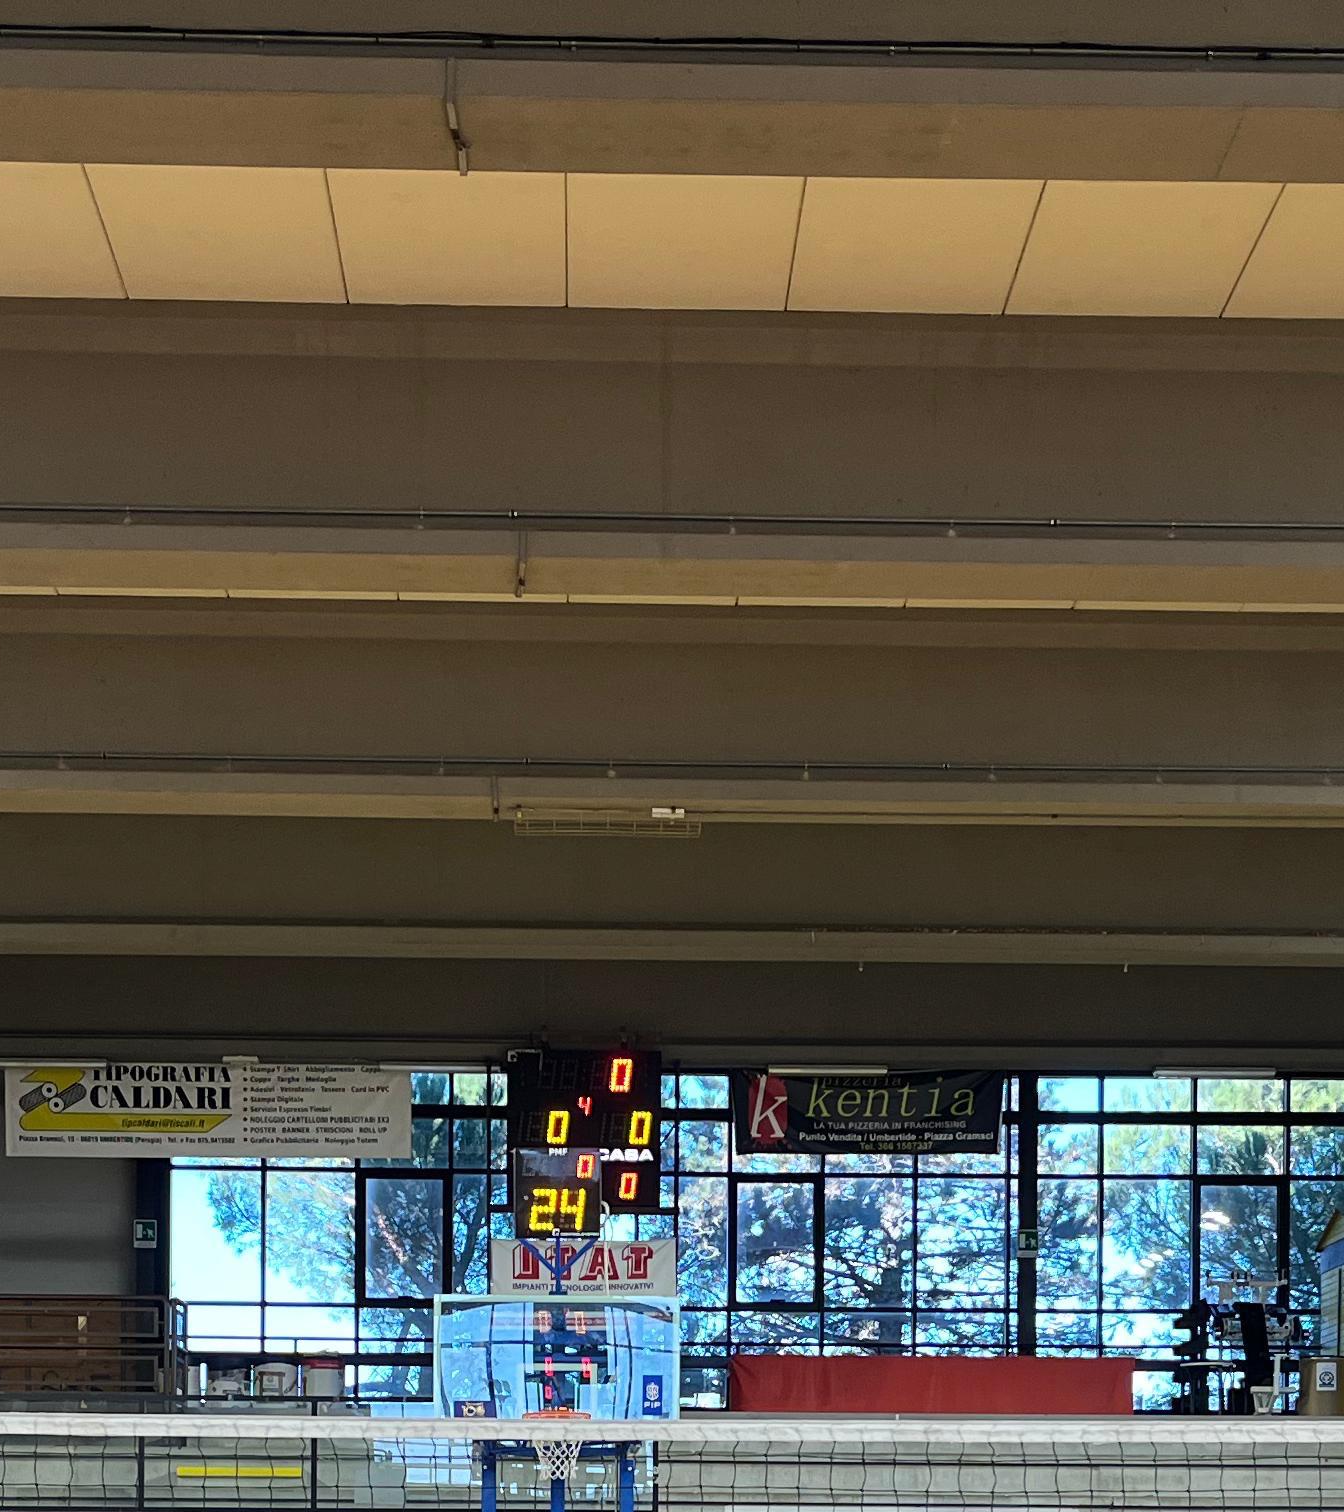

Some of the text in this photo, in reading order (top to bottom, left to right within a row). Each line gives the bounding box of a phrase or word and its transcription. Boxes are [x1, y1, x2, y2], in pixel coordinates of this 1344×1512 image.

[93, 1066, 232, 1082] TIPOGRAFIA
[609, 1058, 633, 1093] 0
[89, 1085, 232, 1110] CALDARI
[805, 1077, 975, 1117] kentia
[547, 1110, 570, 1145] 0
[629, 1110, 652, 1145] 0
[799, 1131, 994, 1142] Punto Vendita Umbertide Piazza Gramsci
[814, 1121, 825, 1129] LA
[828, 1121, 846, 1129] TUA
[848, 1121, 890, 1129] PIZZERIA
[904, 1120, 966, 1129] FRANCHISING
[528, 1188, 586, 1231] 24
[512, 1282, 548, 1291] IMPIANTI
